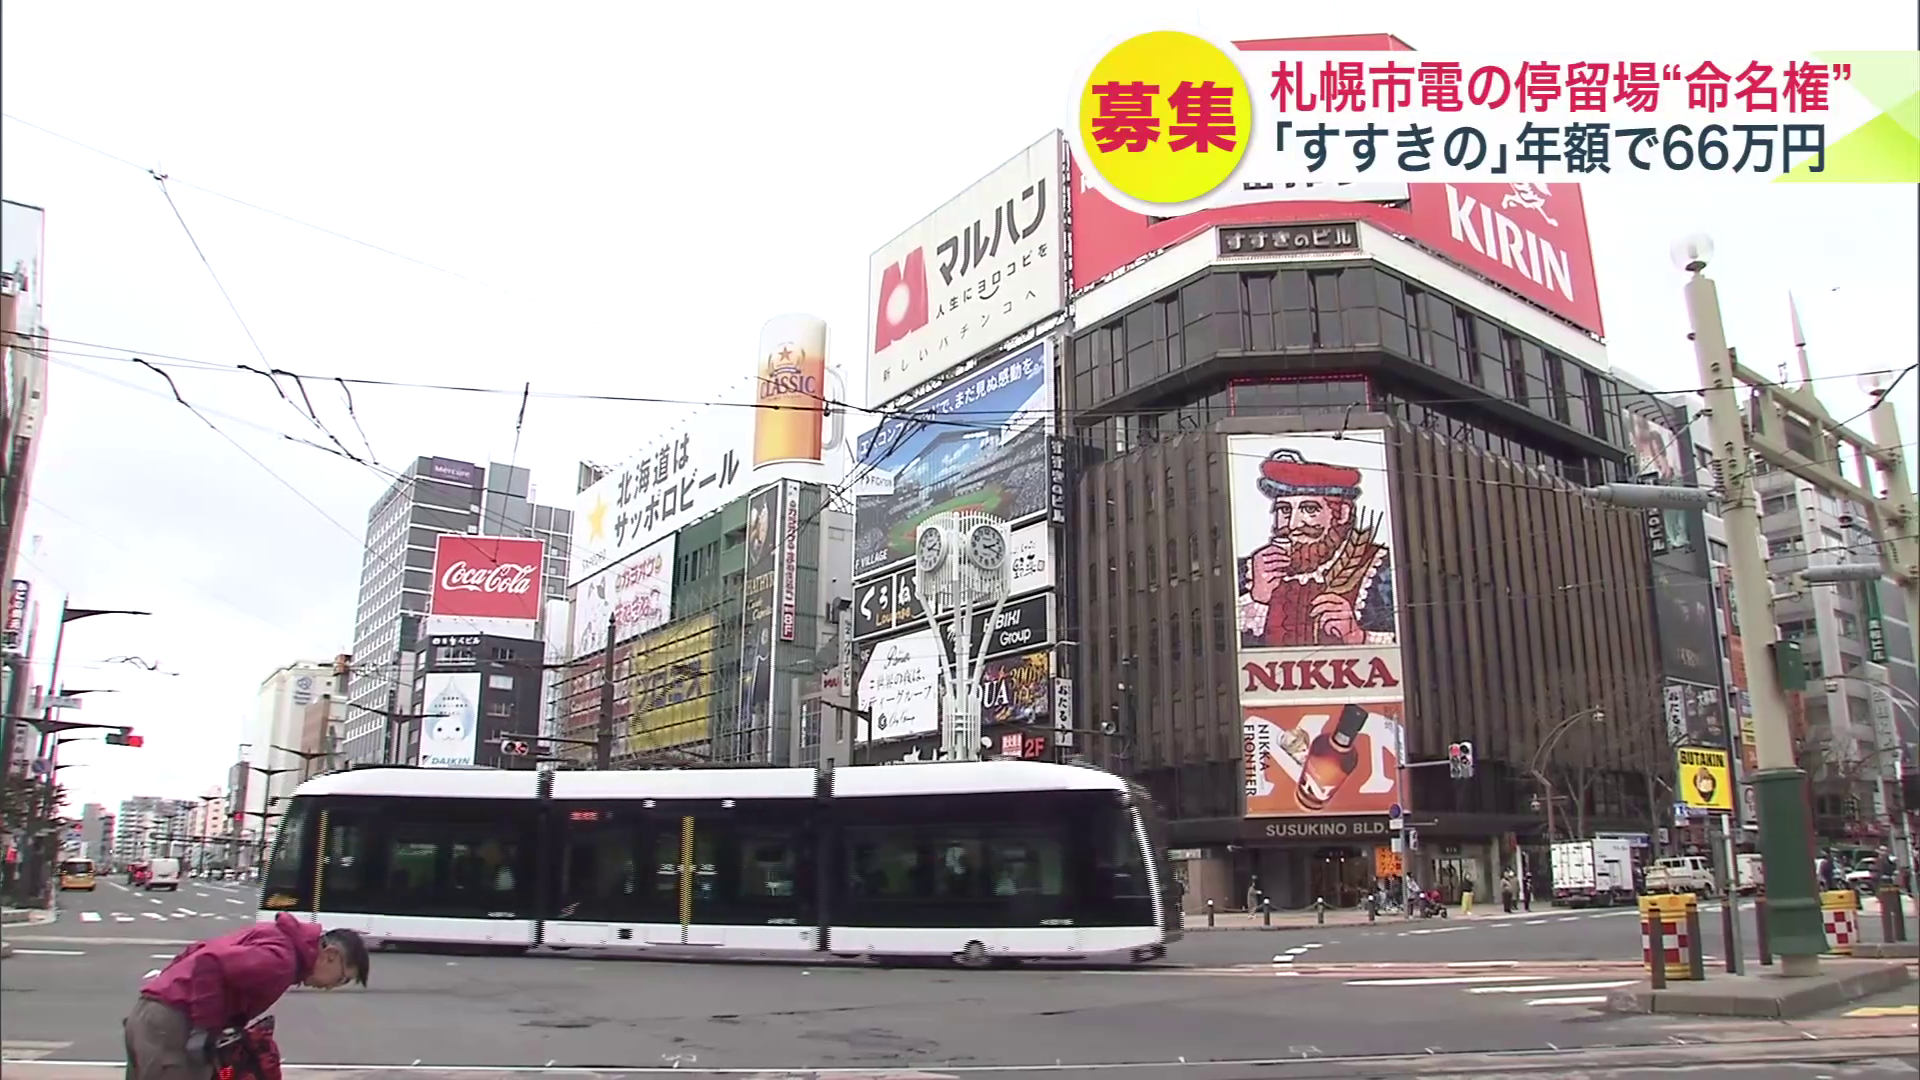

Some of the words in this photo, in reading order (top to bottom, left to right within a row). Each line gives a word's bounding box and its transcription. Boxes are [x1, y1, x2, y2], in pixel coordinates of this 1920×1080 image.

[936, 177, 1046, 287] マルハン
[1225, 227, 1352, 250] すすきのビル
[1446, 182, 1575, 302] KIRIN
[936, 243, 1048, 318] 人生にヨロコビを
[882, 290, 1036, 382] 新しいパチンコへ
[760, 375, 816, 399] CLASSIC
[617, 432, 690, 509] 北海道は
[614, 449, 740, 547] サッポロビール
[861, 549, 888, 568] VILLAGE
[441, 560, 538, 595] Coca-Cola
[983, 609, 1021, 632] HBIKI
[1000, 628, 1031, 646] Group
[1241, 656, 1399, 693] NIKKA
[431, 757, 471, 765] DAIKIN
[1024, 738, 1045, 759] 2F
[1244, 724, 1257, 797] FRONTIER
[1257, 723, 1270, 772] NIKKA
[1266, 822, 1347, 837] SUSUKINO
[1353, 822, 1389, 836] BLD.
